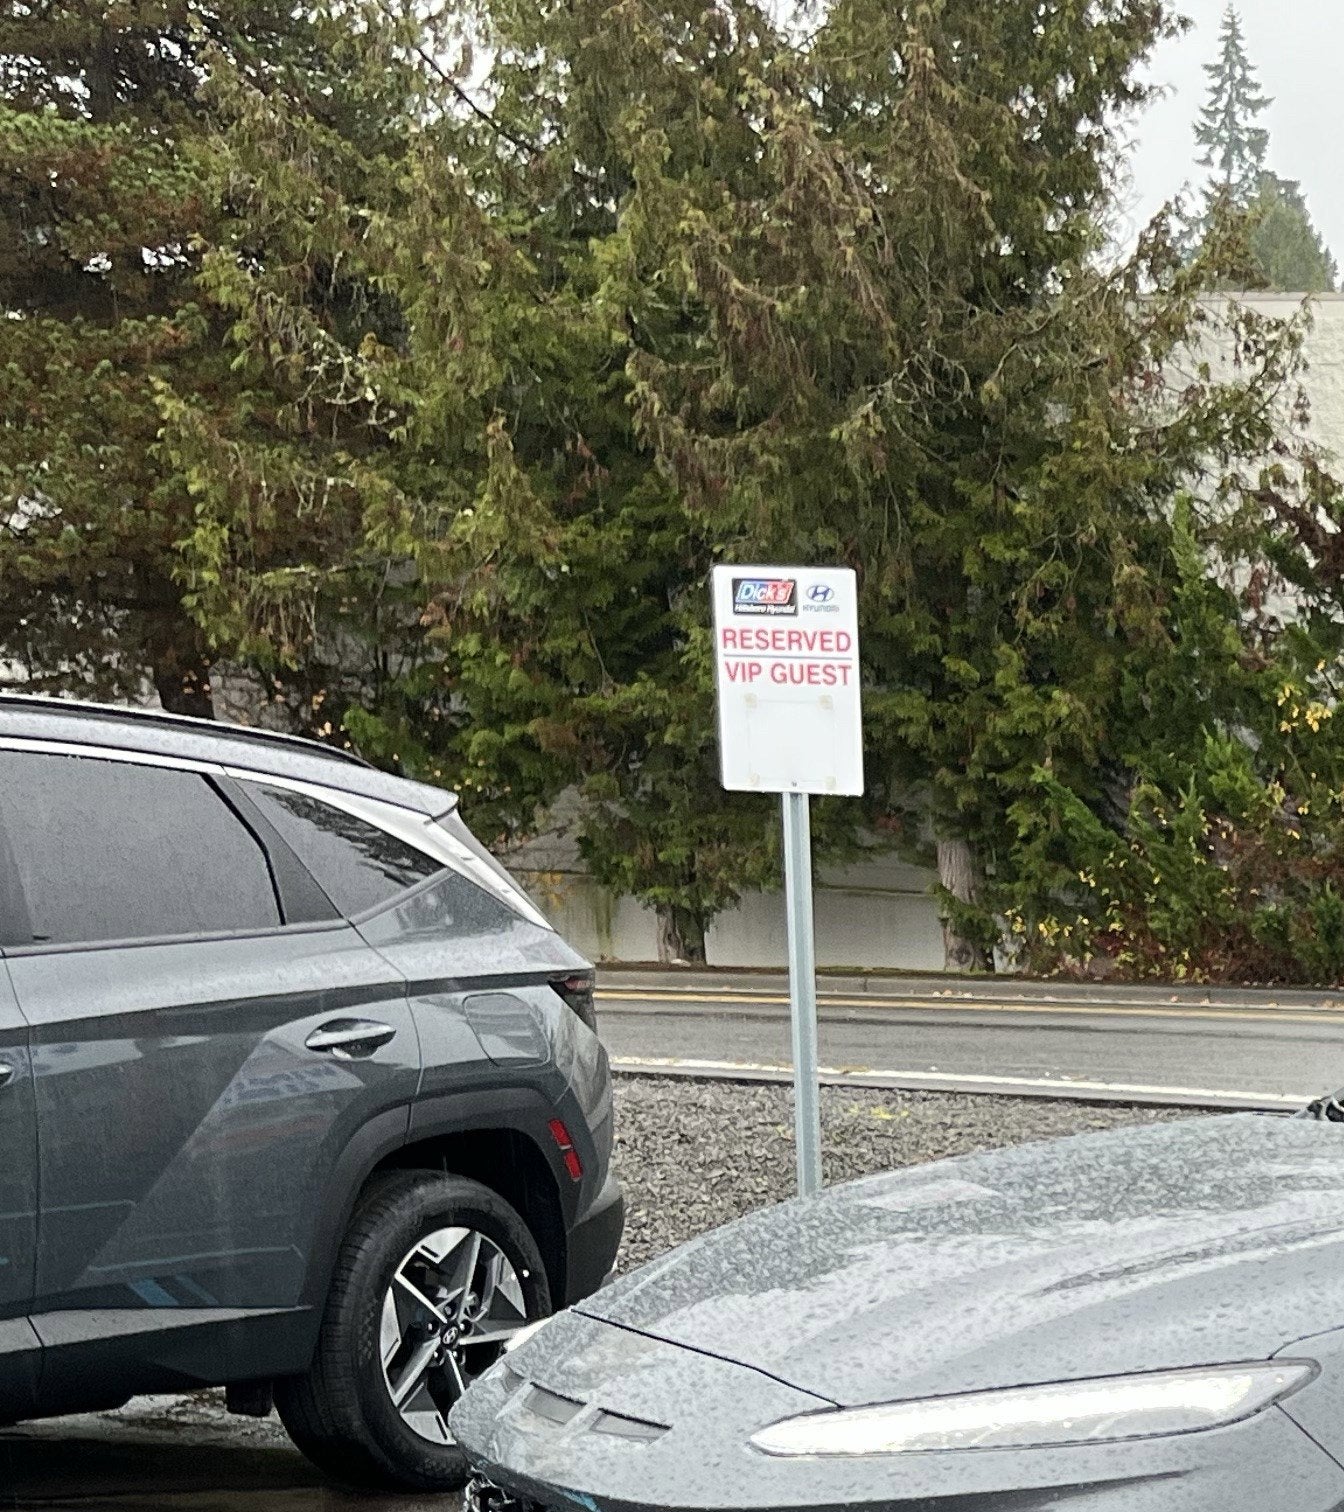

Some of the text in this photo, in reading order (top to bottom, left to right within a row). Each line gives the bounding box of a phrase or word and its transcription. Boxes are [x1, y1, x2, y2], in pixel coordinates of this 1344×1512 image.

[722, 627, 852, 652] RESERVED
[725, 661, 852, 686] VIP GUEST
